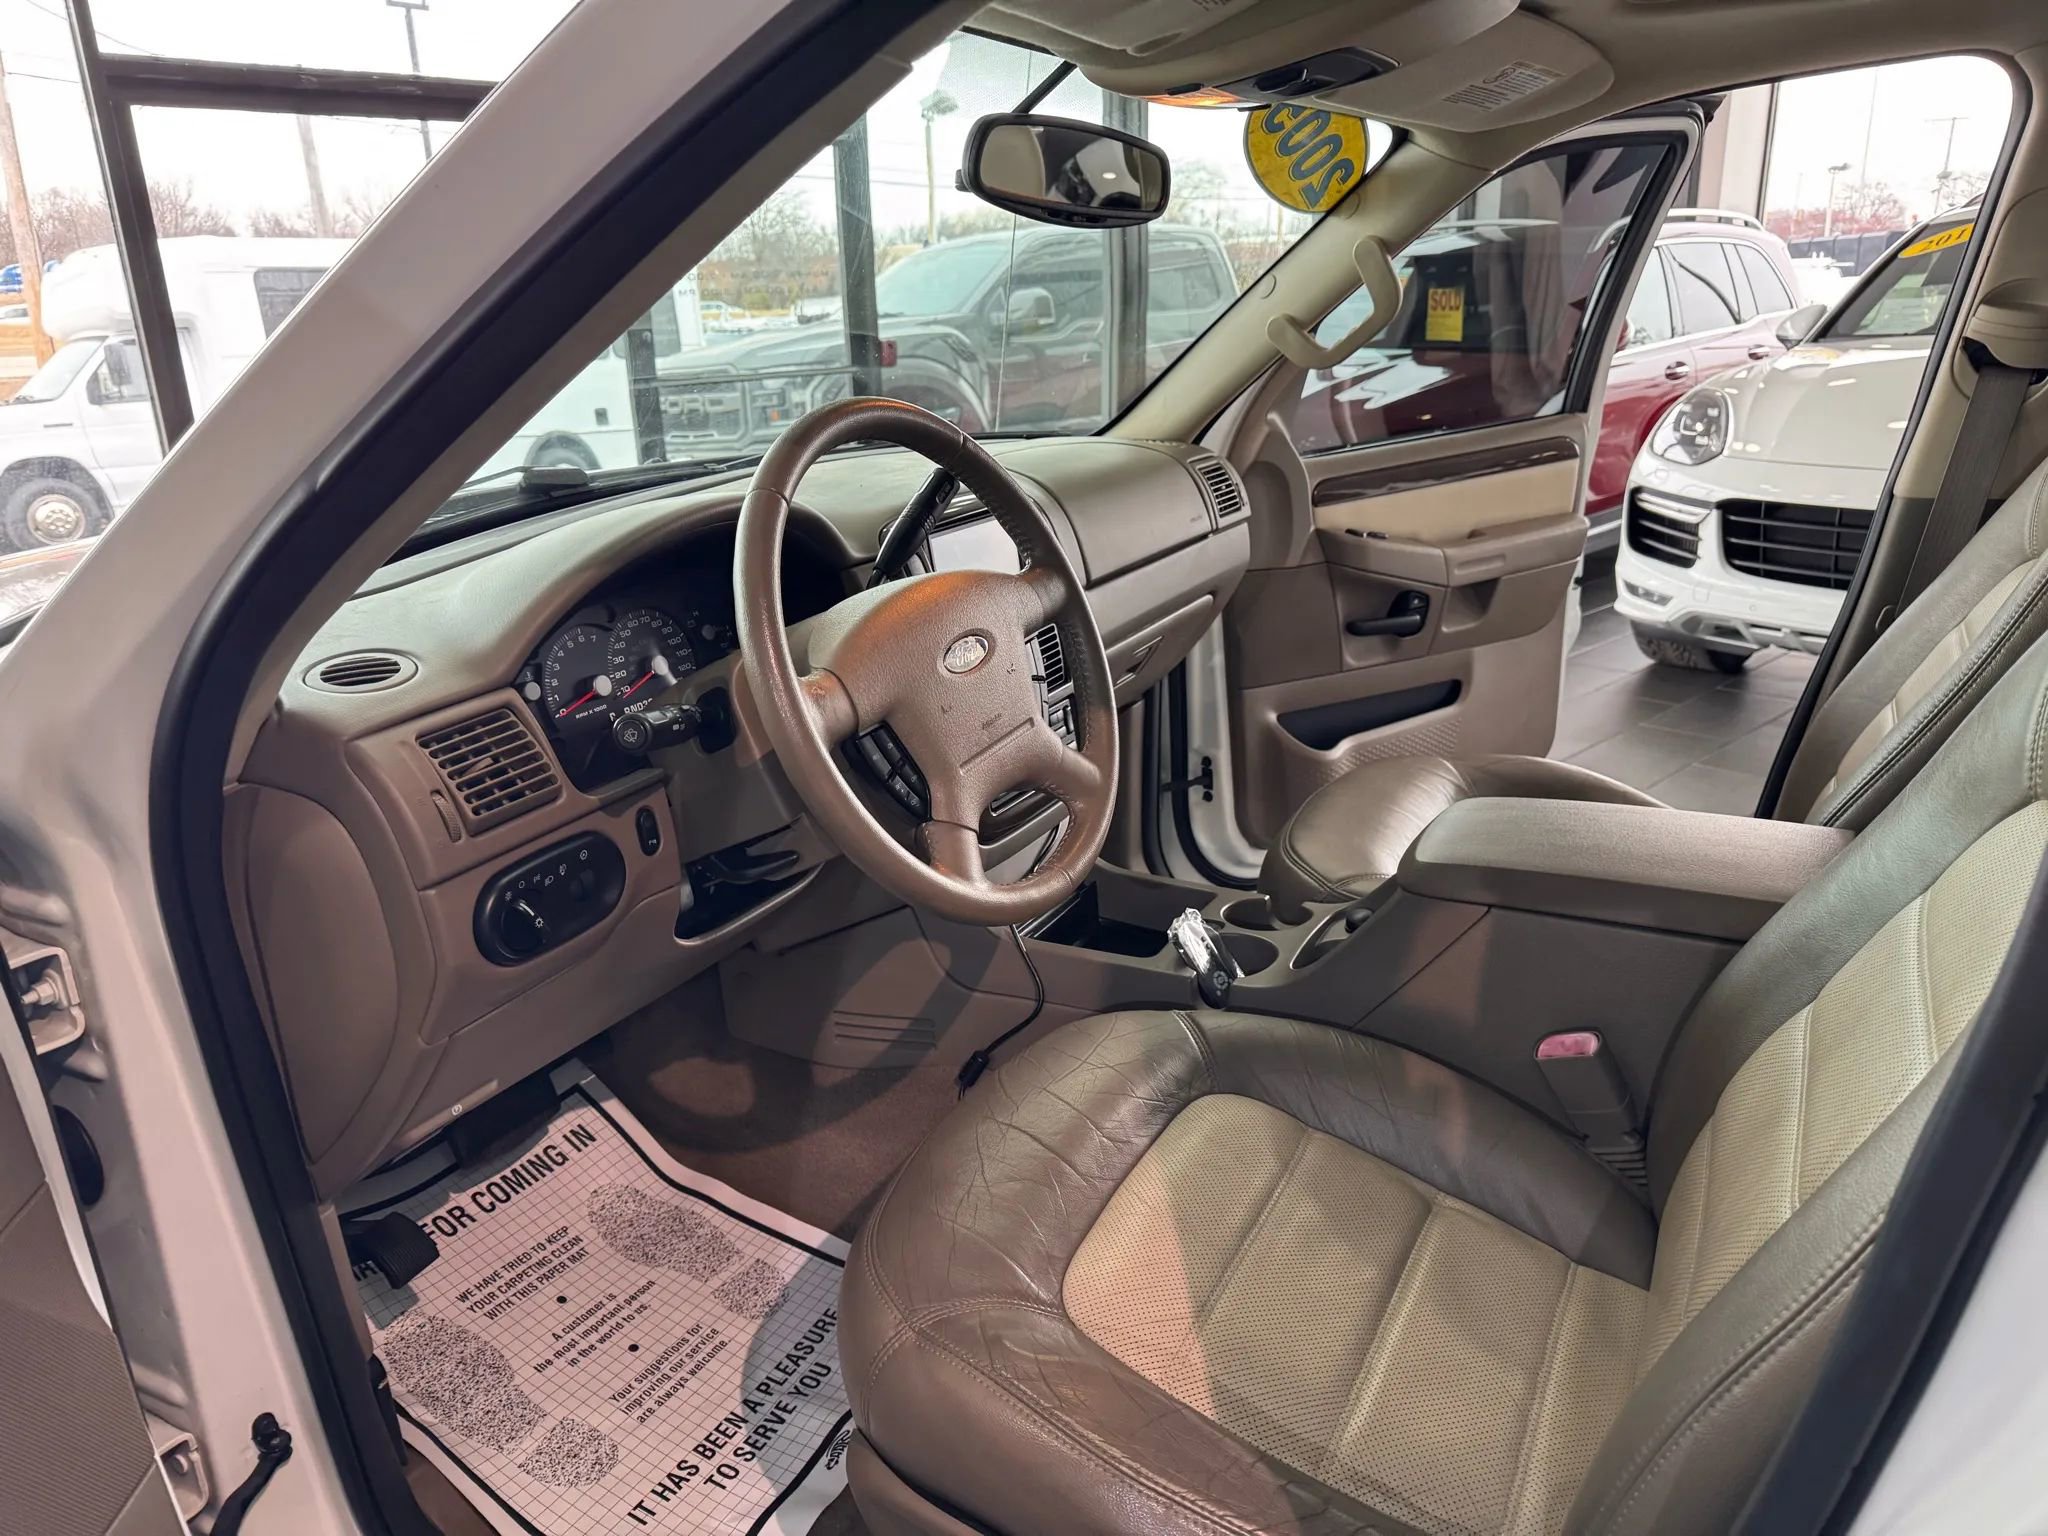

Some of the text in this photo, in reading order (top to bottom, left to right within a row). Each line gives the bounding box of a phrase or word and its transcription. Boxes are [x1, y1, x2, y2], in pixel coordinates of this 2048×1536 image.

[1918, 227, 1969, 252] 201
[1430, 289, 1461, 311] SOLD
[471, 1144, 569, 1213] COMING
[562, 1123, 597, 1153] IN
[456, 1225, 569, 1303] WE HAVE TRIED TO KEEP
[467, 1235, 584, 1314] YOUR CARPETING CLEAN
[483, 1247, 590, 1321] WITH THIS PAPER MAT
[533, 1280, 656, 1373] the most important person
[552, 1292, 617, 1342] A customer is
[565, 1302, 652, 1367] in the world to us.
[608, 1323, 703, 1403] Your suggestions for
[621, 1328, 719, 1416] improving our service
[637, 1338, 732, 1423] are always welcome.
[627, 1500, 657, 1526] IT
[651, 1459, 700, 1502] HAS
[692, 1411, 749, 1461] BEEN
[742, 1398, 765, 1414] A
[703, 1362, 832, 1491] TO SERVE YOU
